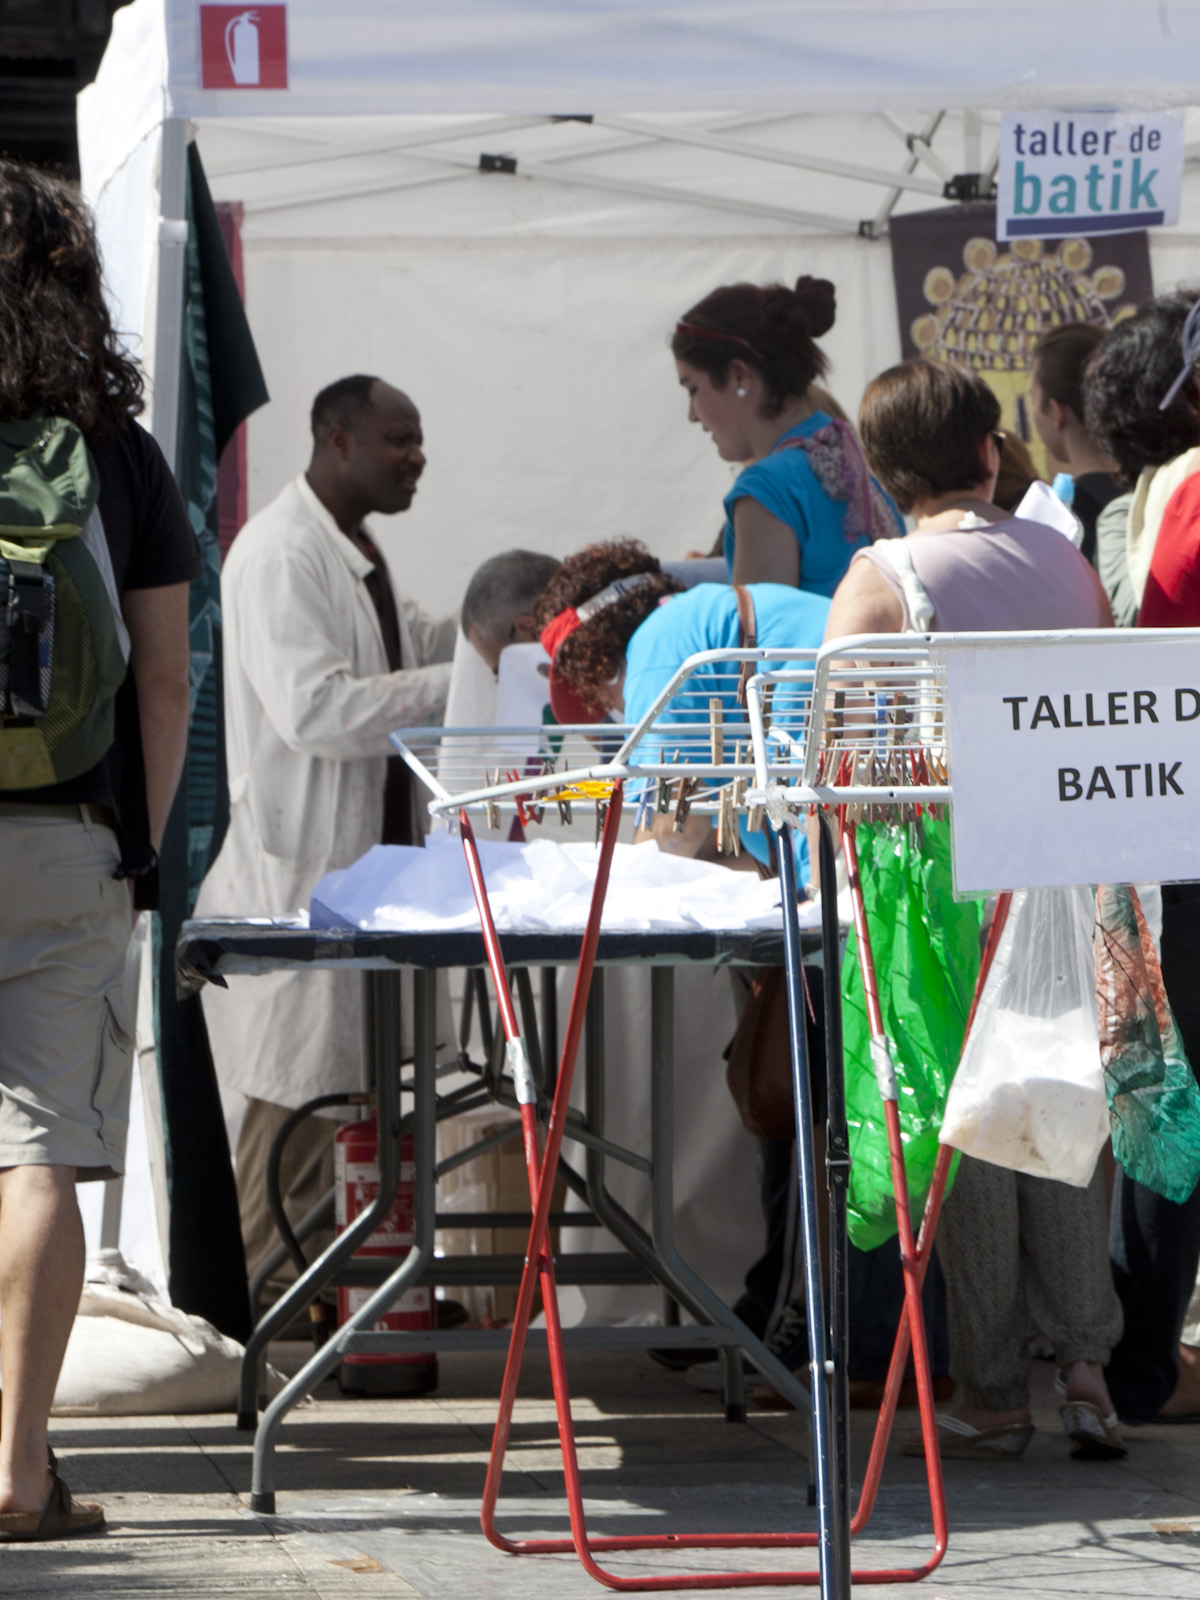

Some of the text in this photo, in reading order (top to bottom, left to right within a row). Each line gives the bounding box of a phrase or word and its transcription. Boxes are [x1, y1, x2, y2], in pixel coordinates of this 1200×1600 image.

[1013, 121, 1161, 156] taller de
[1012, 157, 1160, 216] batik
[1002, 690, 1160, 731] TALLER
[1058, 761, 1185, 801] BATIK
